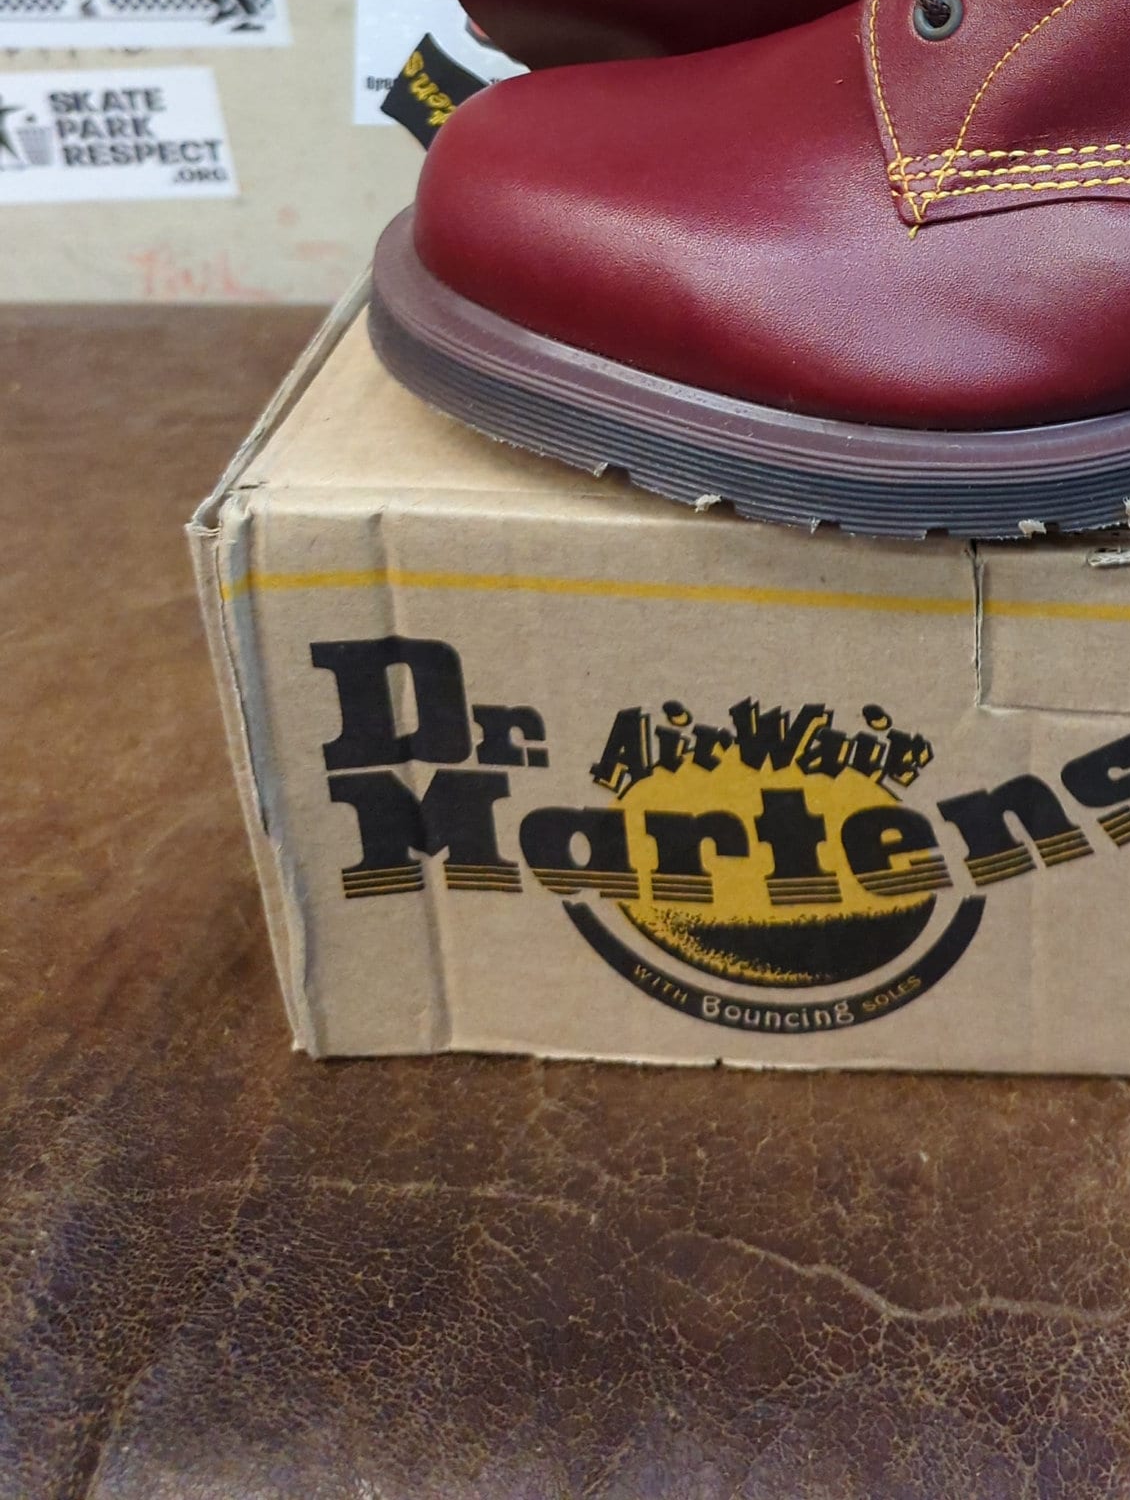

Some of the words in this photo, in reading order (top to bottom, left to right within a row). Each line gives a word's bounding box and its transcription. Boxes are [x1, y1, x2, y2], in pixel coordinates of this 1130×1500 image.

[49, 87, 166, 112] SKATE
[55, 115, 154, 139] PARK
[62, 139, 221, 167] RESPECT
[309, 635, 549, 771] Dr.
[633, 963, 689, 1004] WITH
[702, 994, 855, 1028] Bouncing
[861, 975, 923, 1013] SOLES
